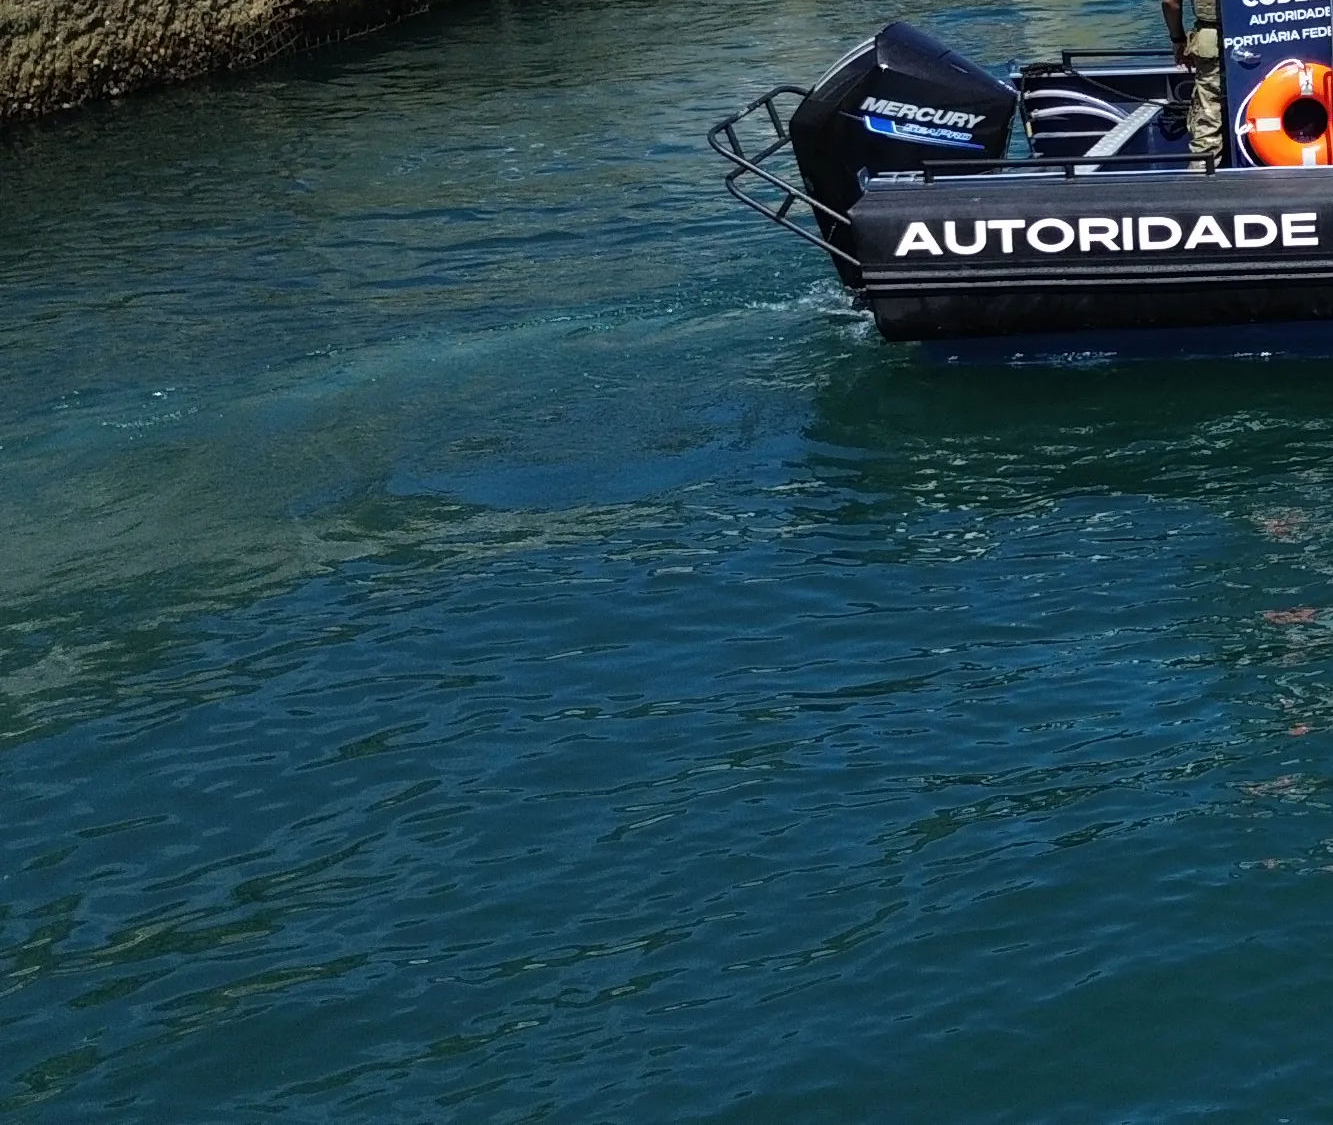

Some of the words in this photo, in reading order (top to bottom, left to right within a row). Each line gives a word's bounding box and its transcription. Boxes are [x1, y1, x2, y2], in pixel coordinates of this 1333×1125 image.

[1249, 6, 1331, 26] AUTORIDADE
[1223, 29, 1301, 50] PORTUÁRIA
[860, 96, 986, 129] MERCURY
[896, 212, 1319, 257] AUTORIDADE
